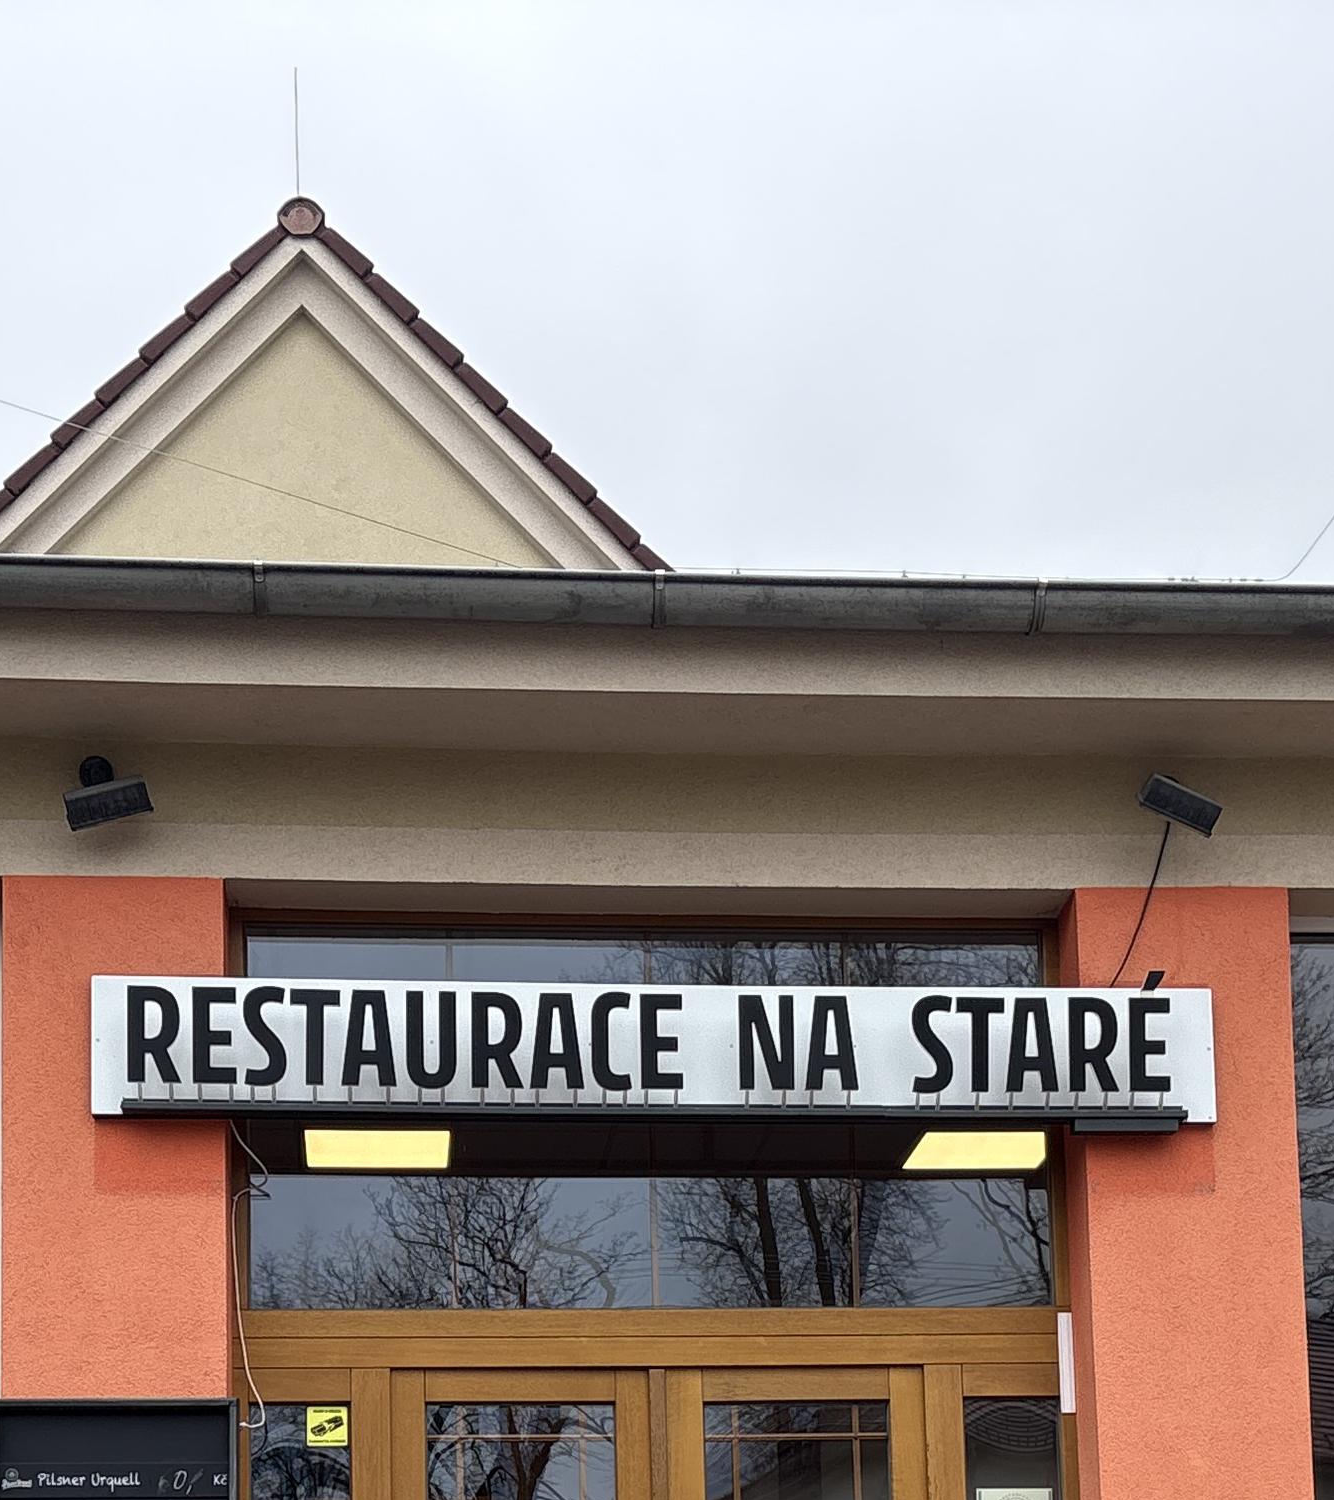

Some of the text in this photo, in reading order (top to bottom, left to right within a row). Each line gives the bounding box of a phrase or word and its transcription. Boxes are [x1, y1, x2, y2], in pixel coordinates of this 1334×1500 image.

[126, 970, 1172, 1093] RESTAURACE NA STARÉ
[37, 1472, 86, 1487] Pilsner
[91, 1472, 141, 1493] Urquell
[213, 1473, 228, 1486] Kč
